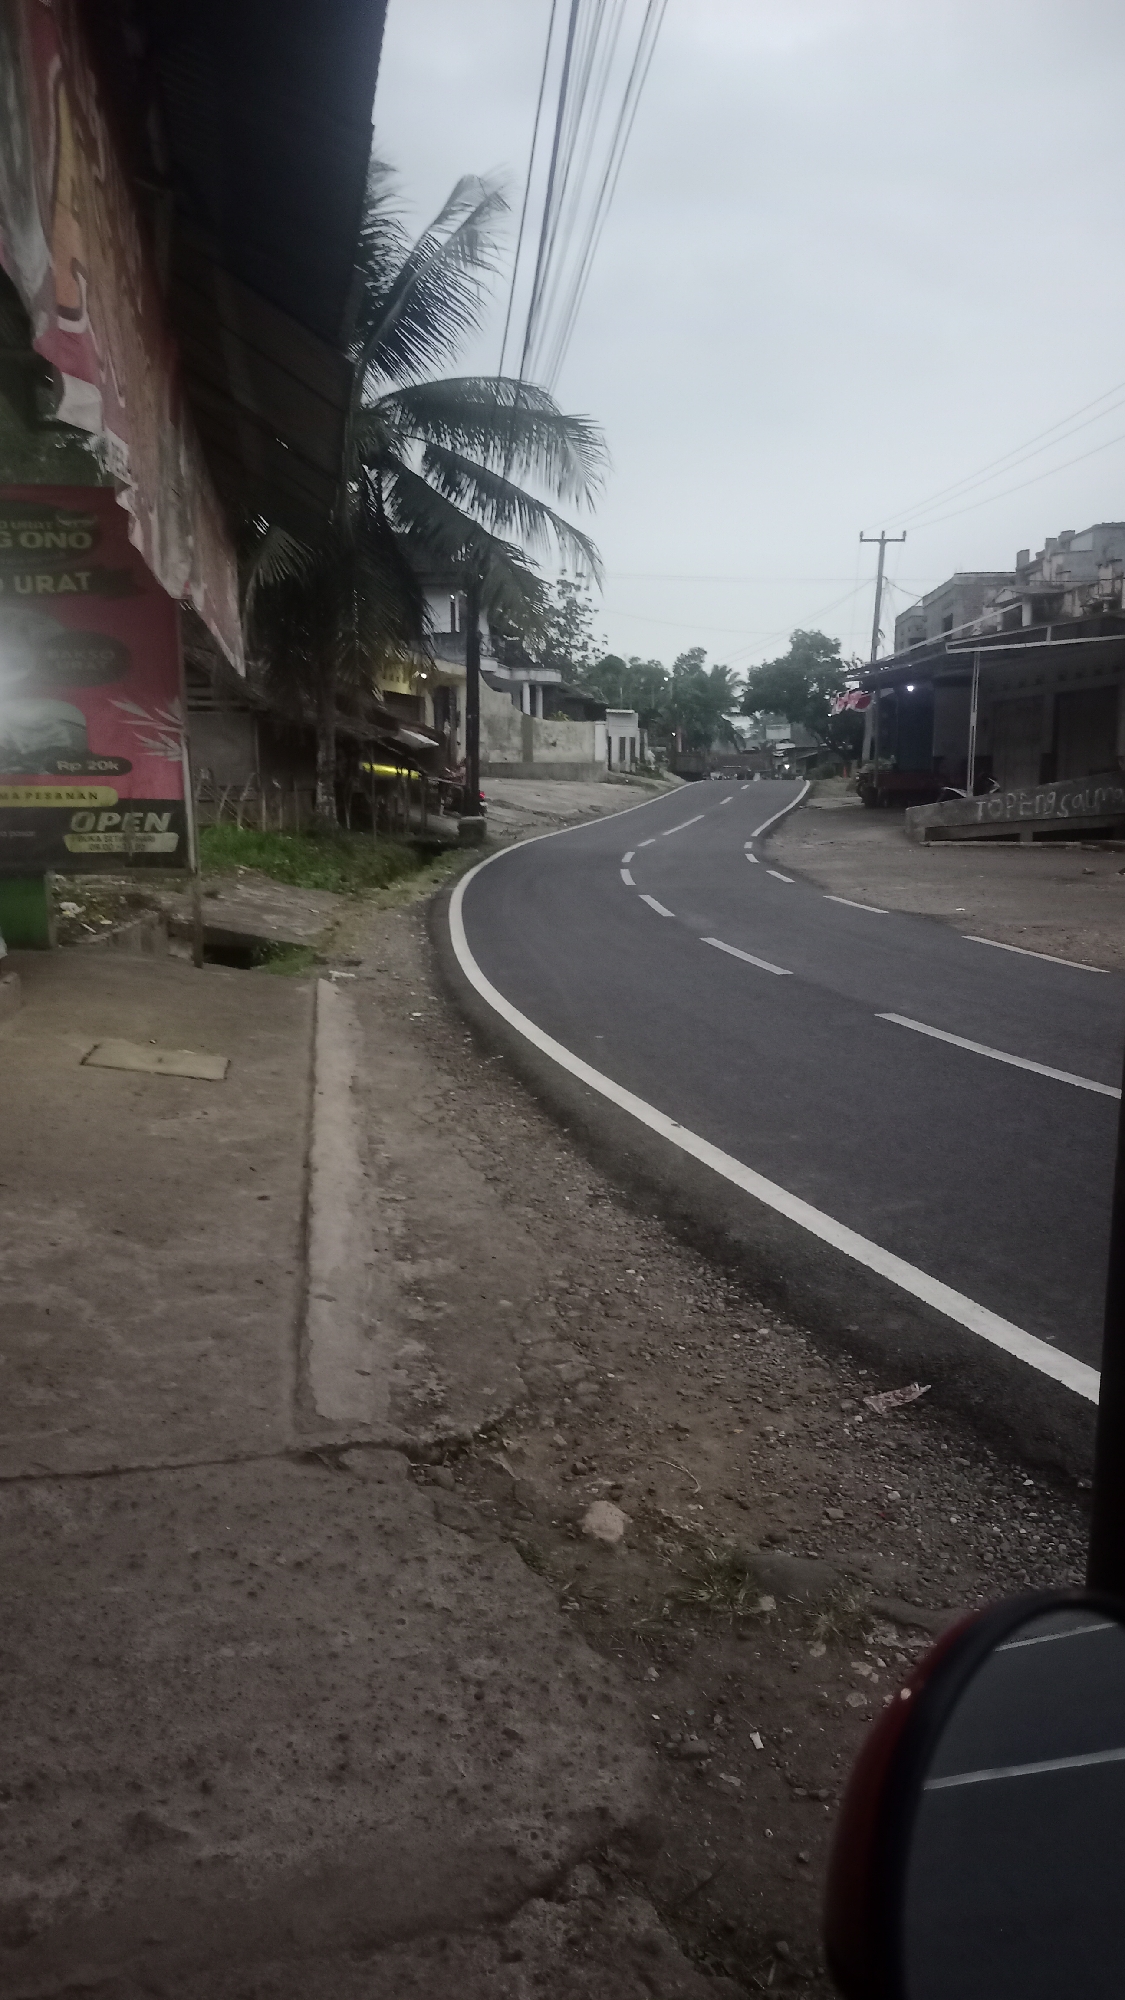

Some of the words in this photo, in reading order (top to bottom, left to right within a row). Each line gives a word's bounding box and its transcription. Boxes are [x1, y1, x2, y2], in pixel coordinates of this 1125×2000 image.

[13, 571, 92, 594] URAT
[56, 760, 82, 773] Rp
[70, 811, 172, 832] OPEN
